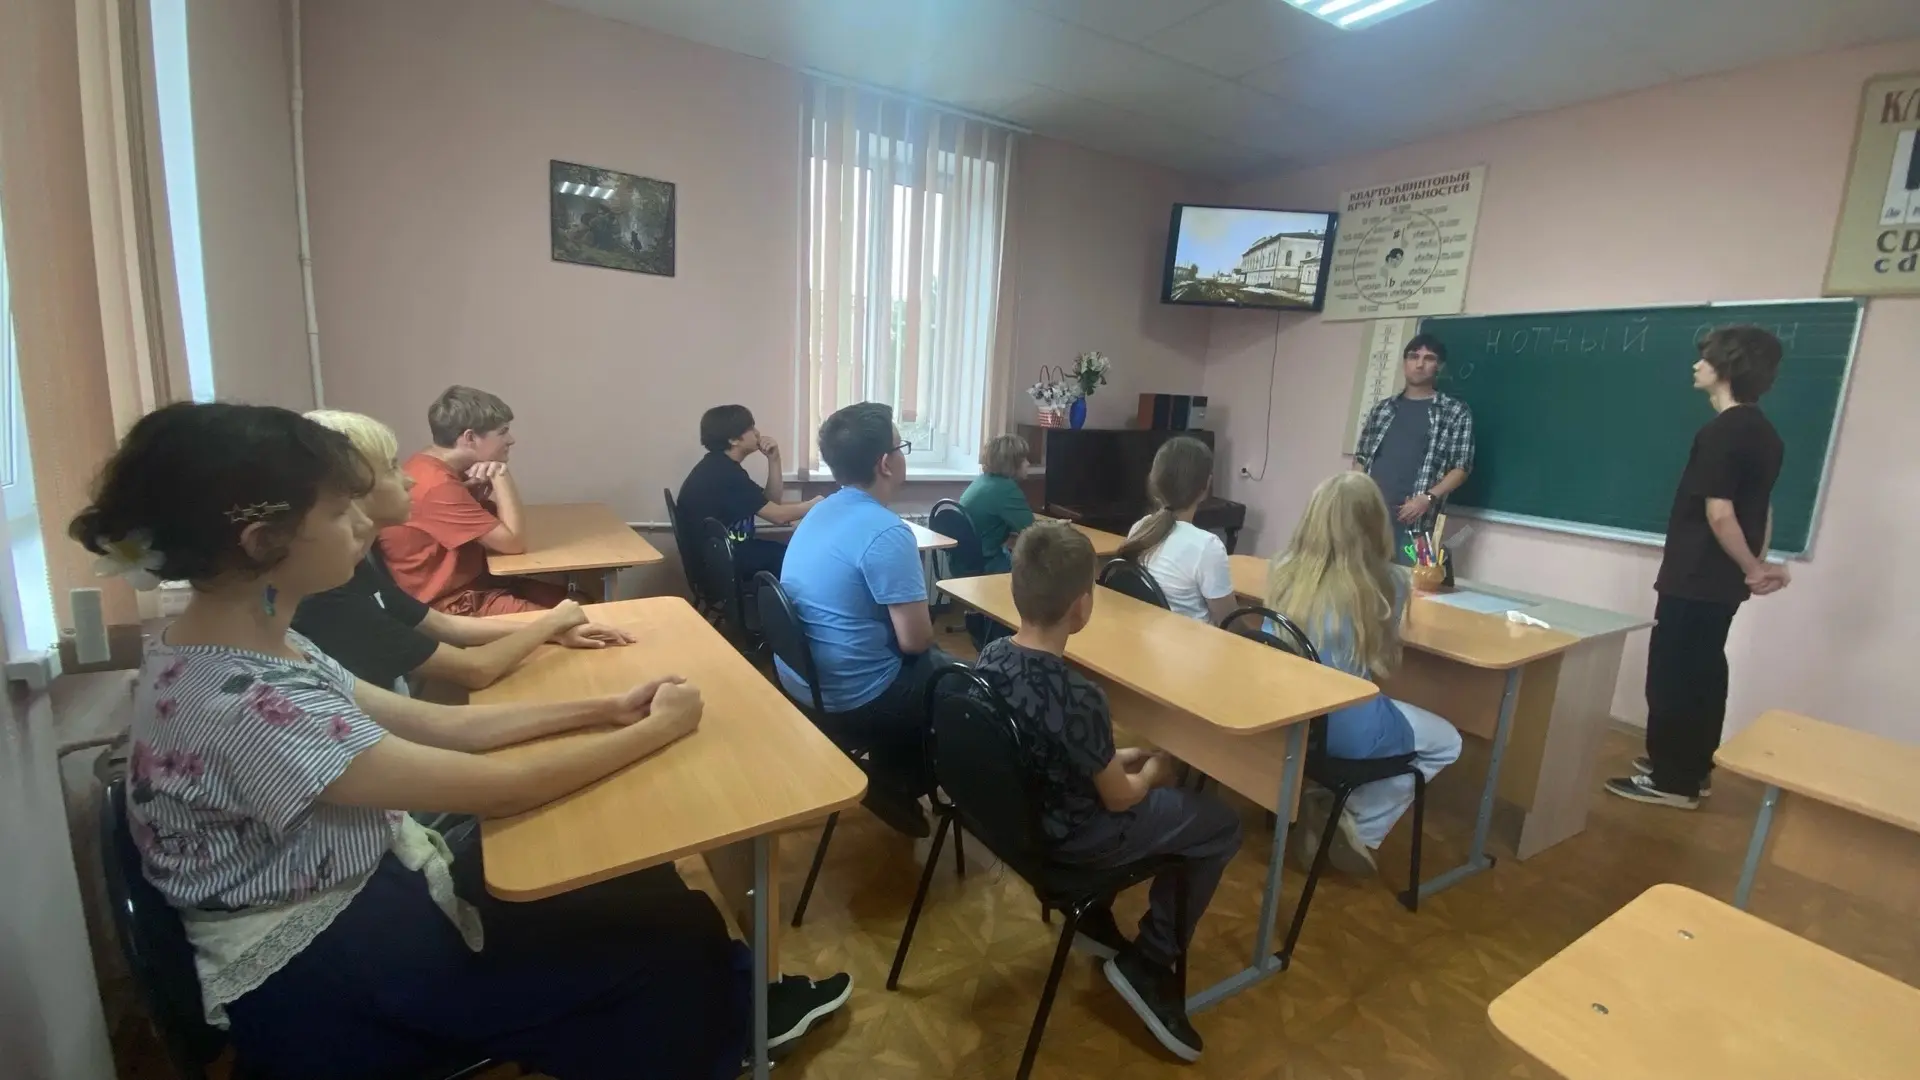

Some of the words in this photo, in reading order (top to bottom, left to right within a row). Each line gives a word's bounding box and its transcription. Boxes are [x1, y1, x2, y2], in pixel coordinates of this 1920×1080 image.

[1346, 198, 1375, 212] КРУГ
[1379, 181, 1470, 207] ТОНАЛЬНОСТЕЙ
[1349, 170, 1471, 201] КВАРТО-КВИНТОВЫЙ
[1486, 316, 1649, 353] НОТНЫЙ
